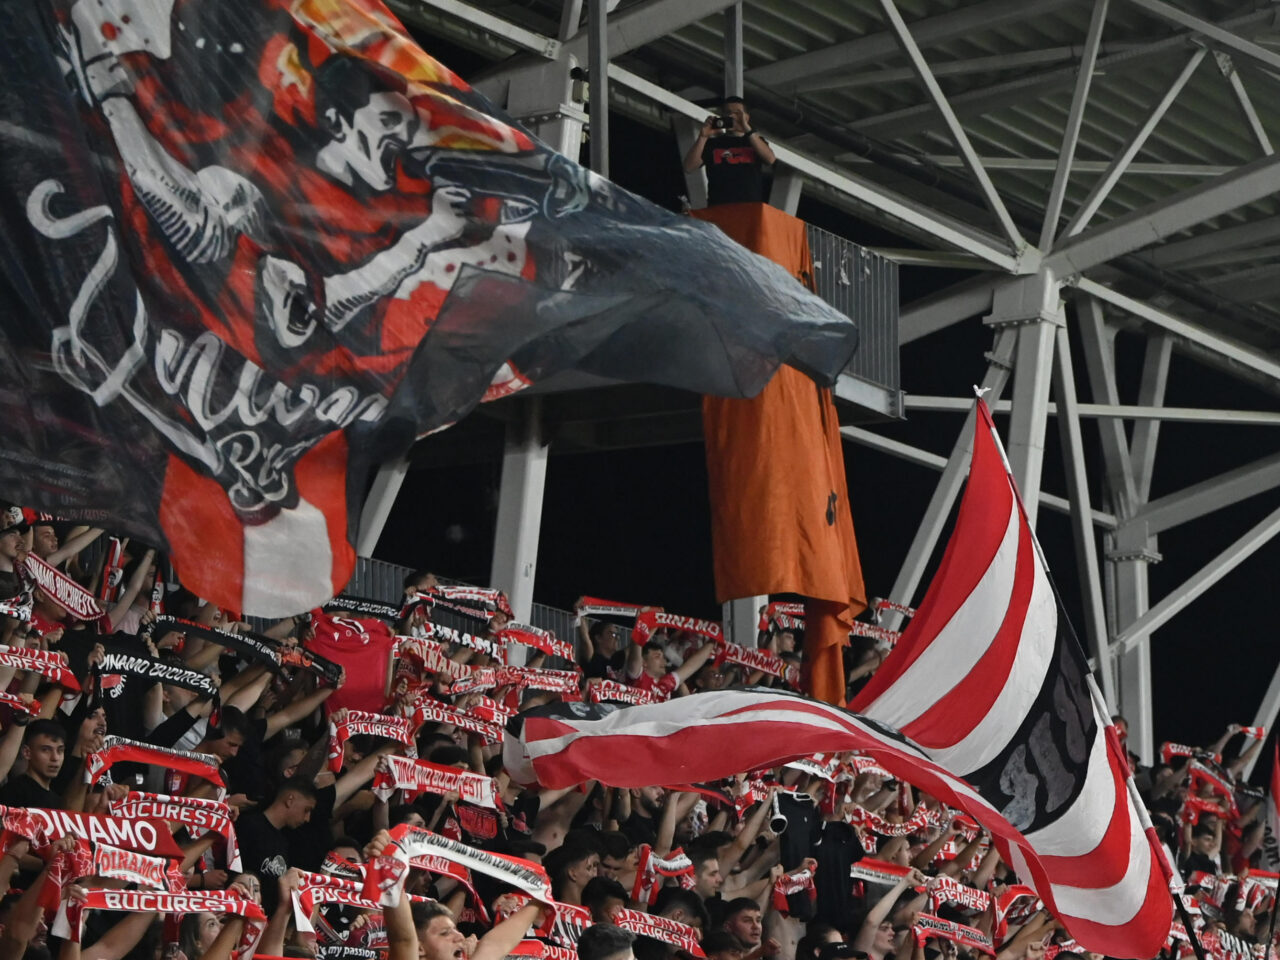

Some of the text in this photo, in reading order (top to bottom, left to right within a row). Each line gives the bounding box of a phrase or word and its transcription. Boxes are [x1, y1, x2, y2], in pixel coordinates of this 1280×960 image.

[655, 611, 719, 636] DINAMO
[98, 653, 149, 675] DINAMO
[27, 807, 157, 851] DINAMO
[101, 850, 163, 883] DINAMO
[104, 892, 248, 918] BUCURESTI
[327, 945, 342, 957] my
